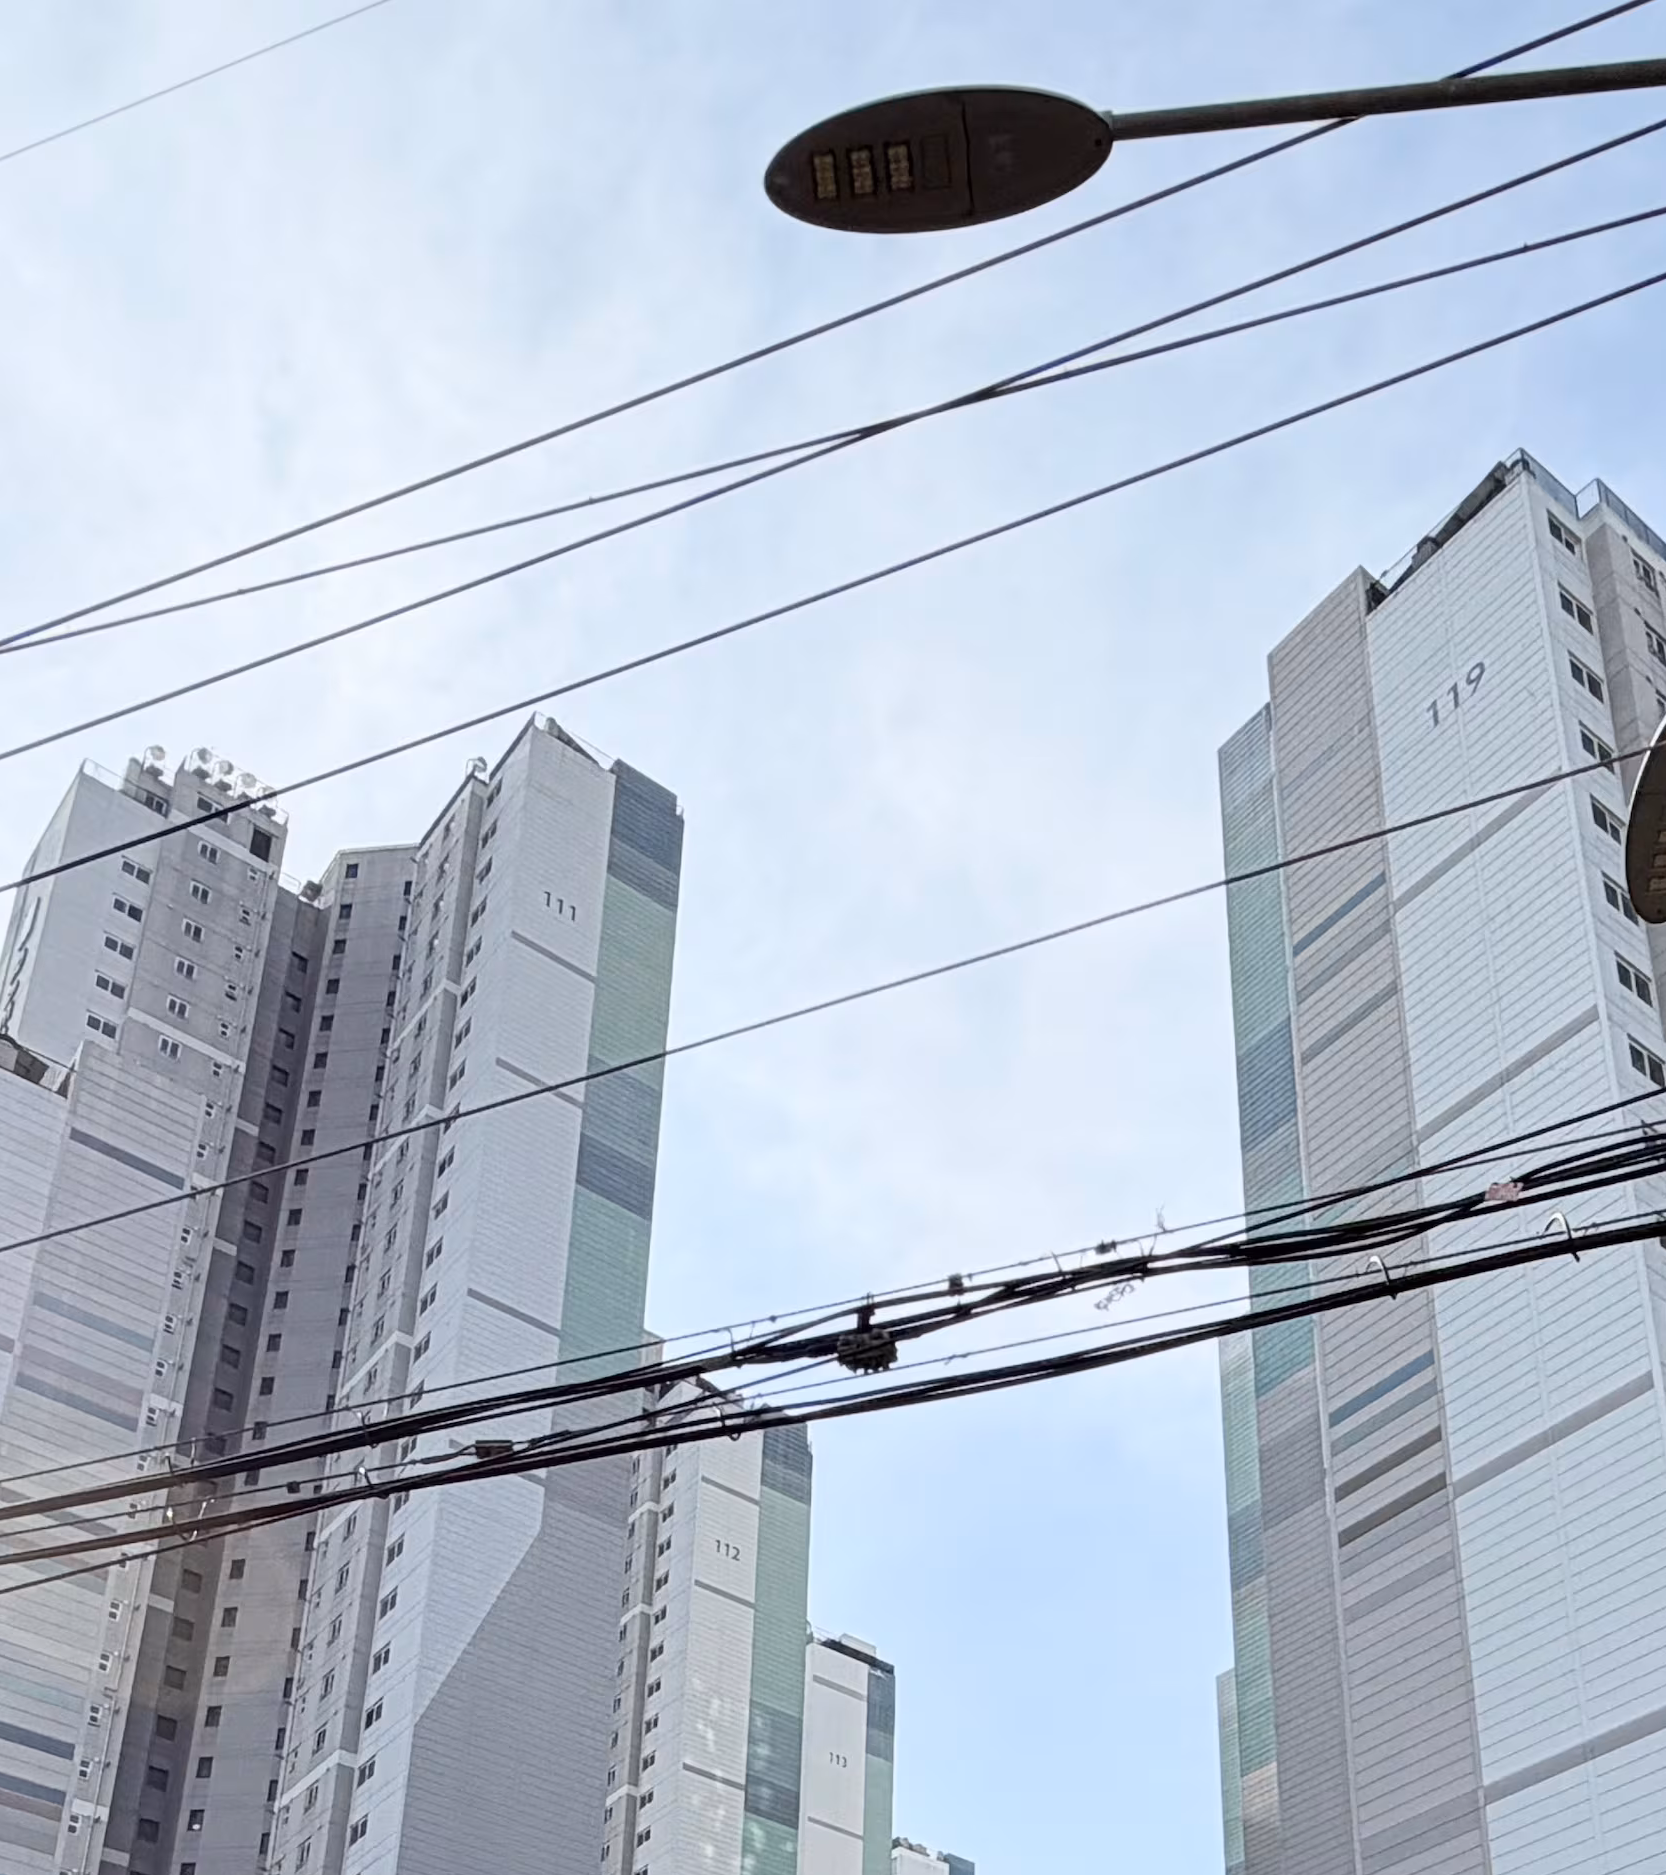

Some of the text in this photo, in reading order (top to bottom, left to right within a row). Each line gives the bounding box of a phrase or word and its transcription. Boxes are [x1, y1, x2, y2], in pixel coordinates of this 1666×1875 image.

[1426, 661, 1486, 728] 119
[543, 890, 577, 922] 111
[714, 1539, 741, 1561] 112
[828, 1751, 848, 1768] 113
